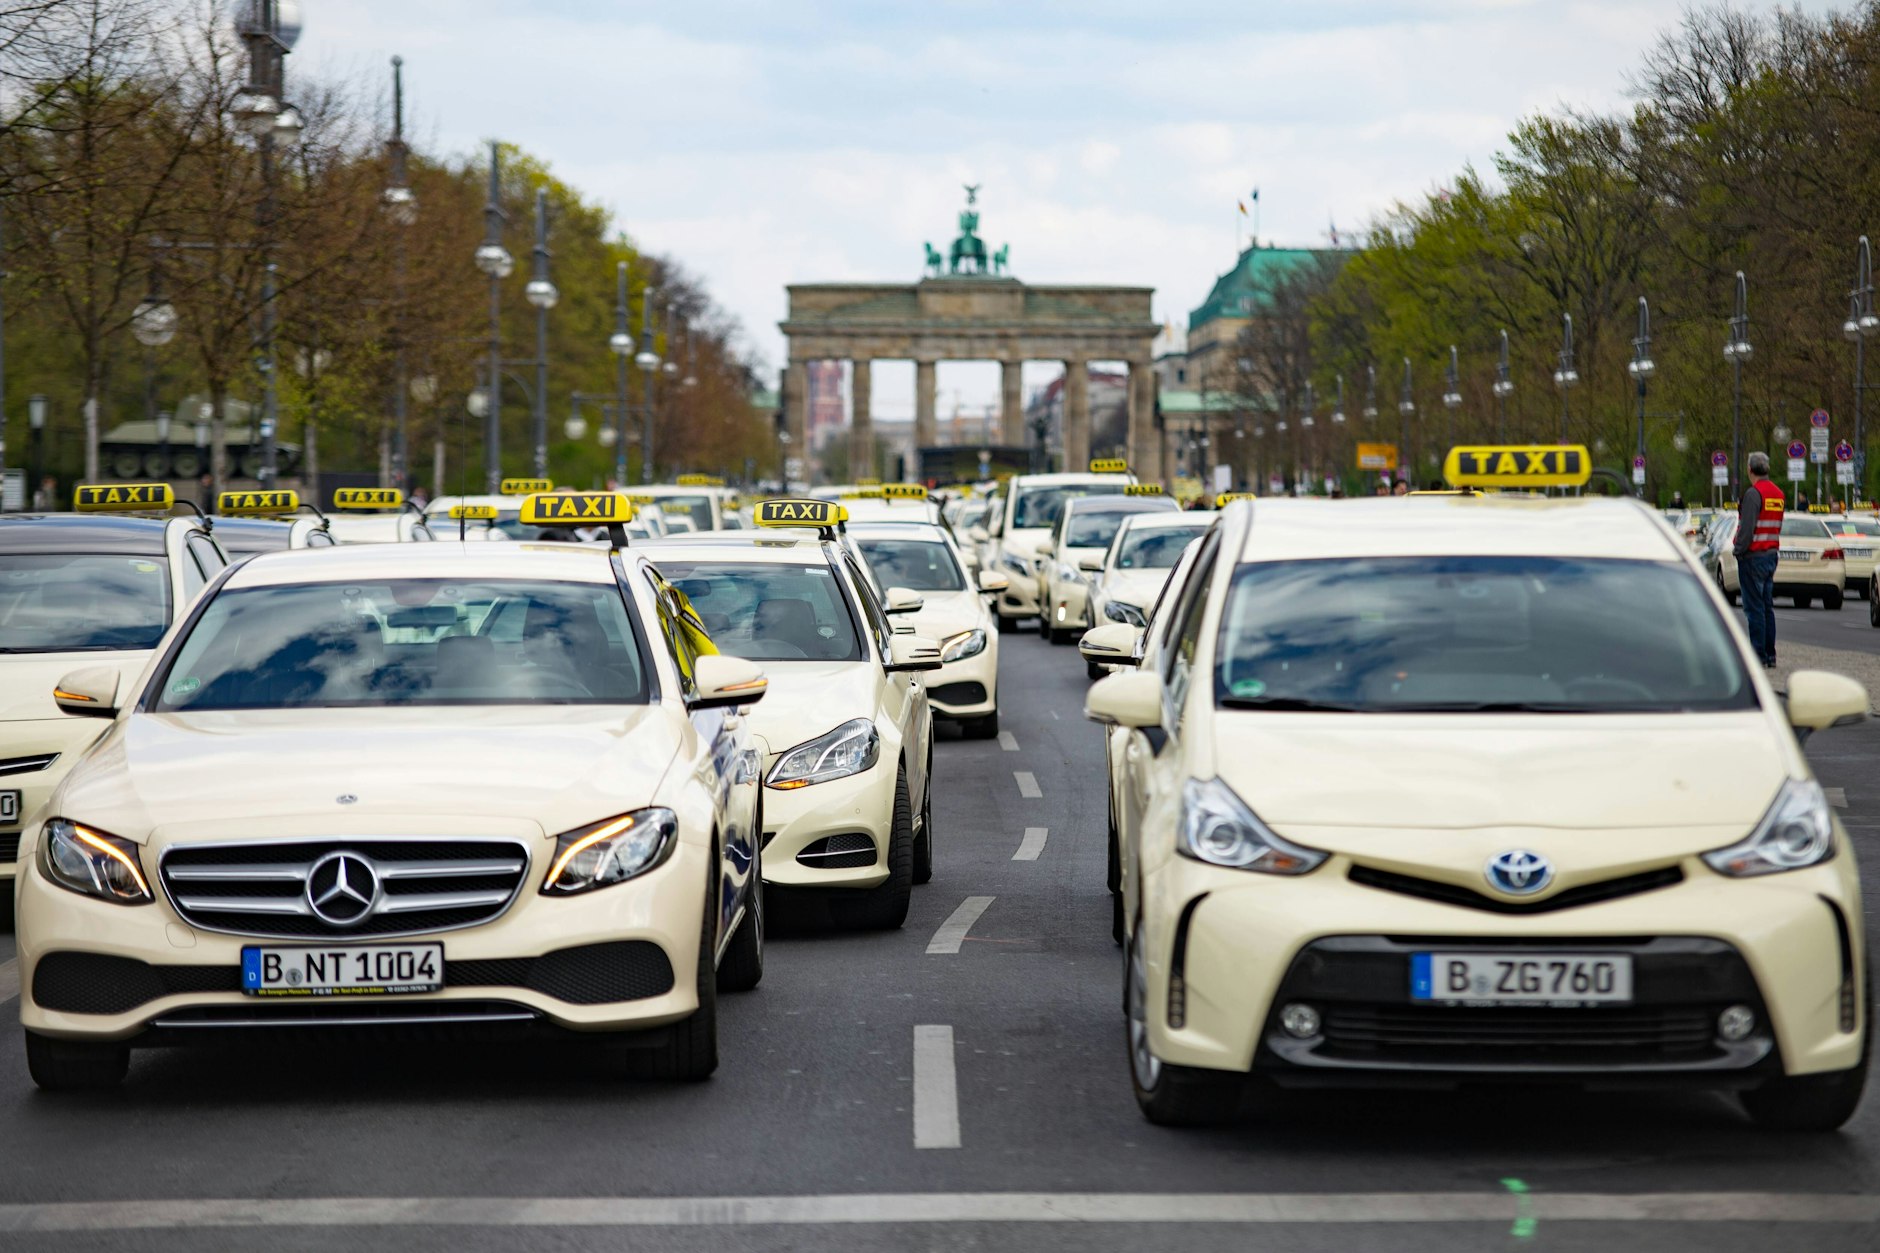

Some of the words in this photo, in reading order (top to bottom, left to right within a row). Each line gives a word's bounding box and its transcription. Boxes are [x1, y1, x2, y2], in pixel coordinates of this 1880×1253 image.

[1471, 452, 1567, 474] TAXI
[89, 487, 154, 504] TAXI
[230, 493, 284, 508] TAXI
[344, 491, 390, 503] TAXI
[539, 496, 613, 517] TAXI
[768, 503, 822, 519] TAXI
[263, 953, 283, 983] B
[306, 952, 347, 983] NT
[355, 951, 436, 982] 1004
[249, 972, 257, 981] D
[1448, 961, 1470, 992] B
